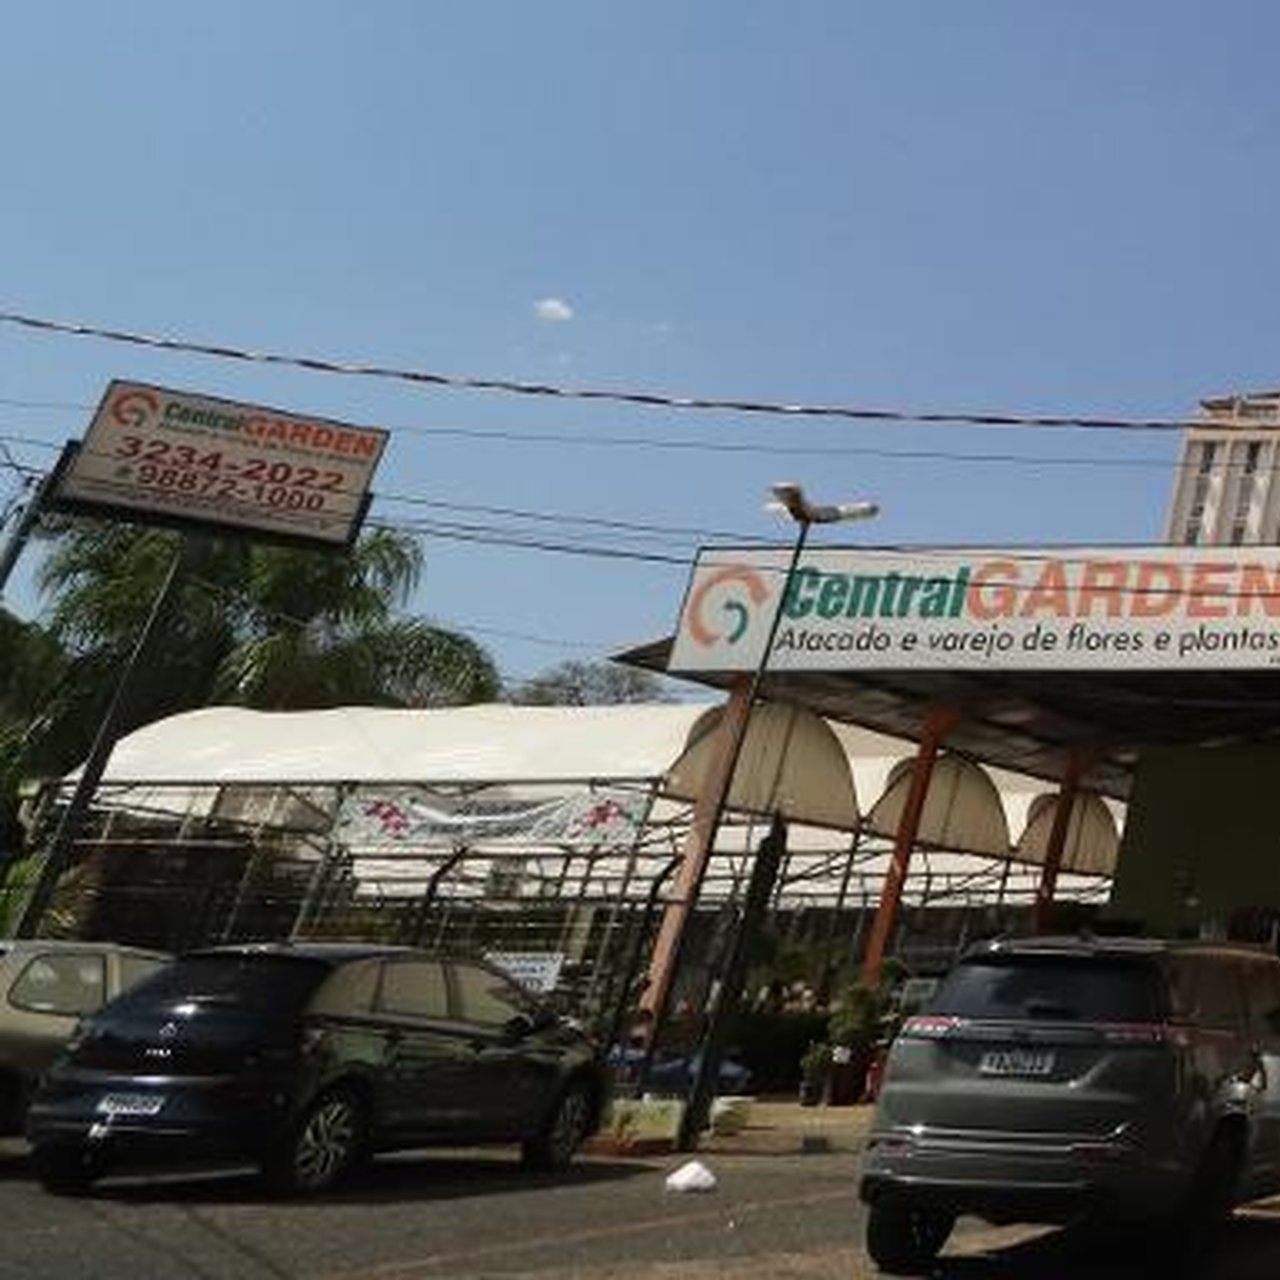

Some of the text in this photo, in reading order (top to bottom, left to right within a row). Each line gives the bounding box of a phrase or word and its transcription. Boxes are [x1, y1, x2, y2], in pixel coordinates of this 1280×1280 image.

[116, 435, 344, 493] 3234-2022
[138, 463, 325, 511] 98872-1000
[774, 624, 1279, 658] Atacado e varejo de flores e plantas
